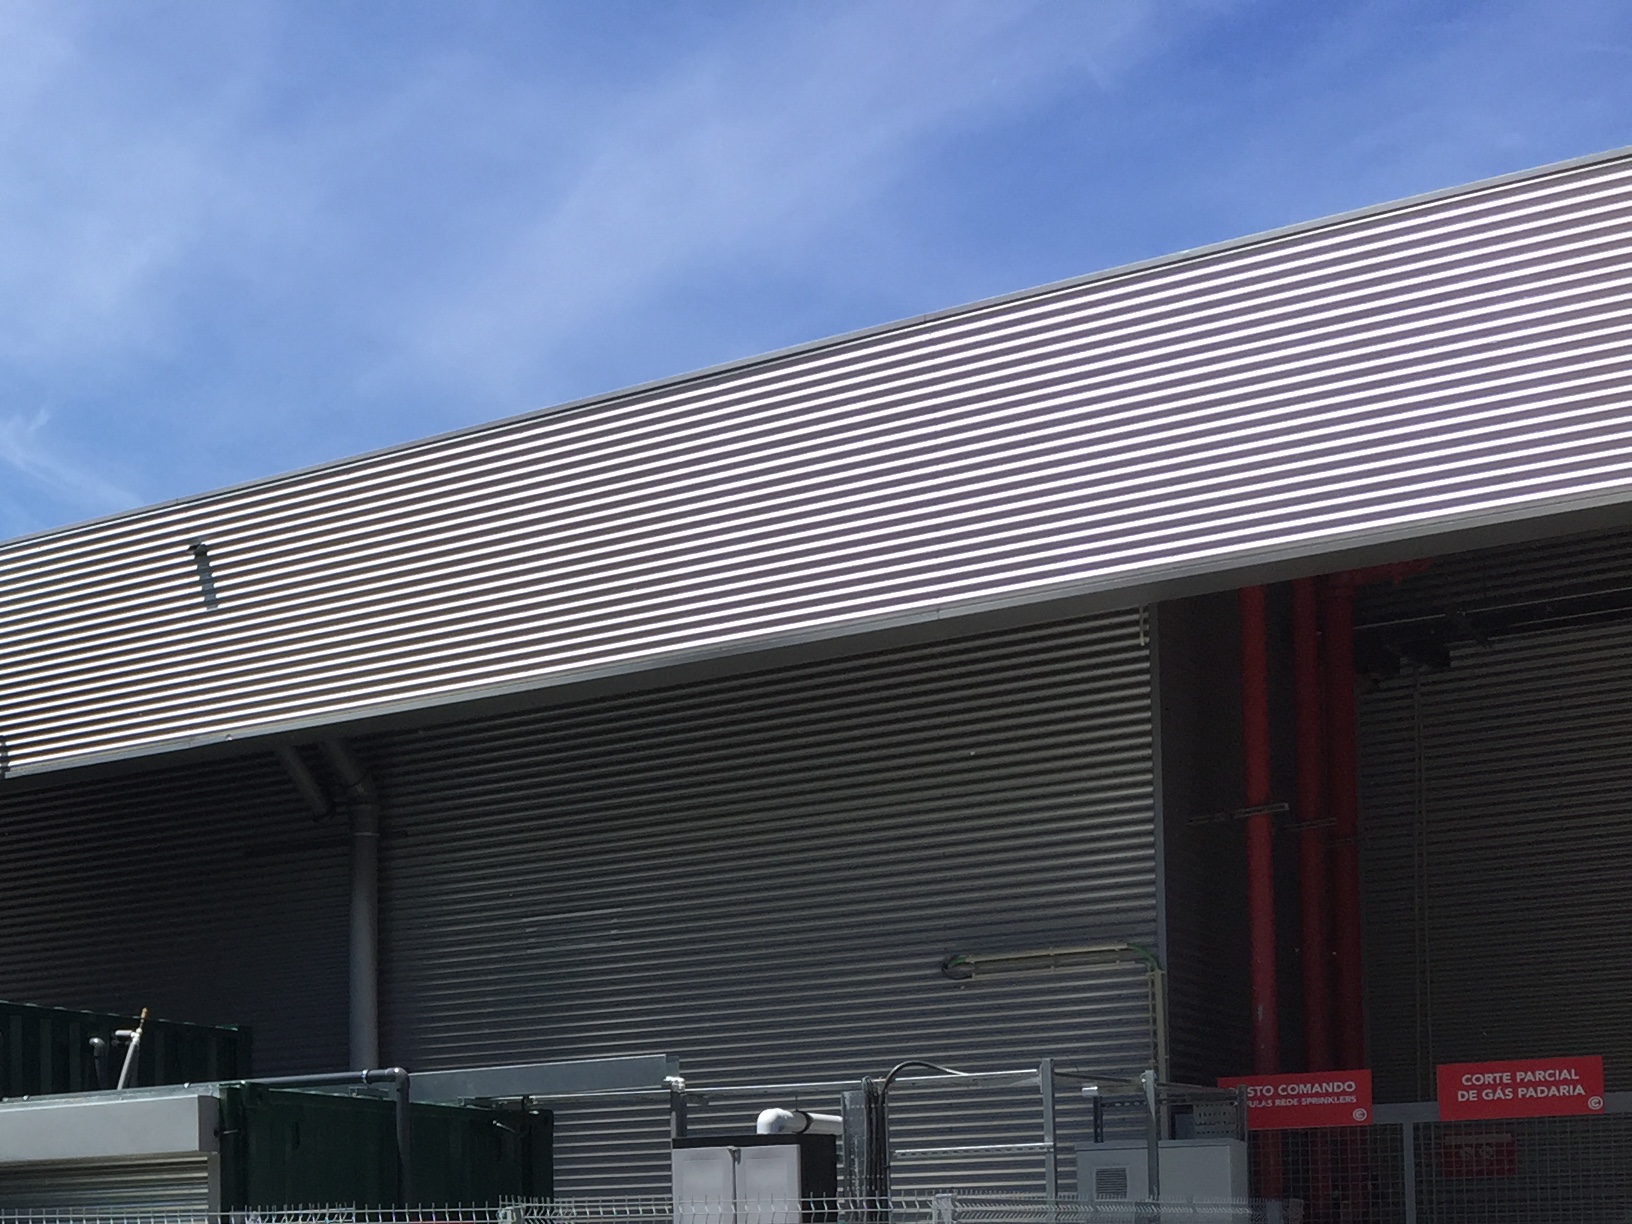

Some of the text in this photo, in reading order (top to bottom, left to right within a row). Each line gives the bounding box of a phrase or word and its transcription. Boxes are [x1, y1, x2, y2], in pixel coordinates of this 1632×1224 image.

[1461, 1068, 1580, 1086] CORTE PARCIAL
[1278, 1081, 1356, 1096] COMANDO
[1457, 1085, 1586, 1102] DE GÁS PADARIA
